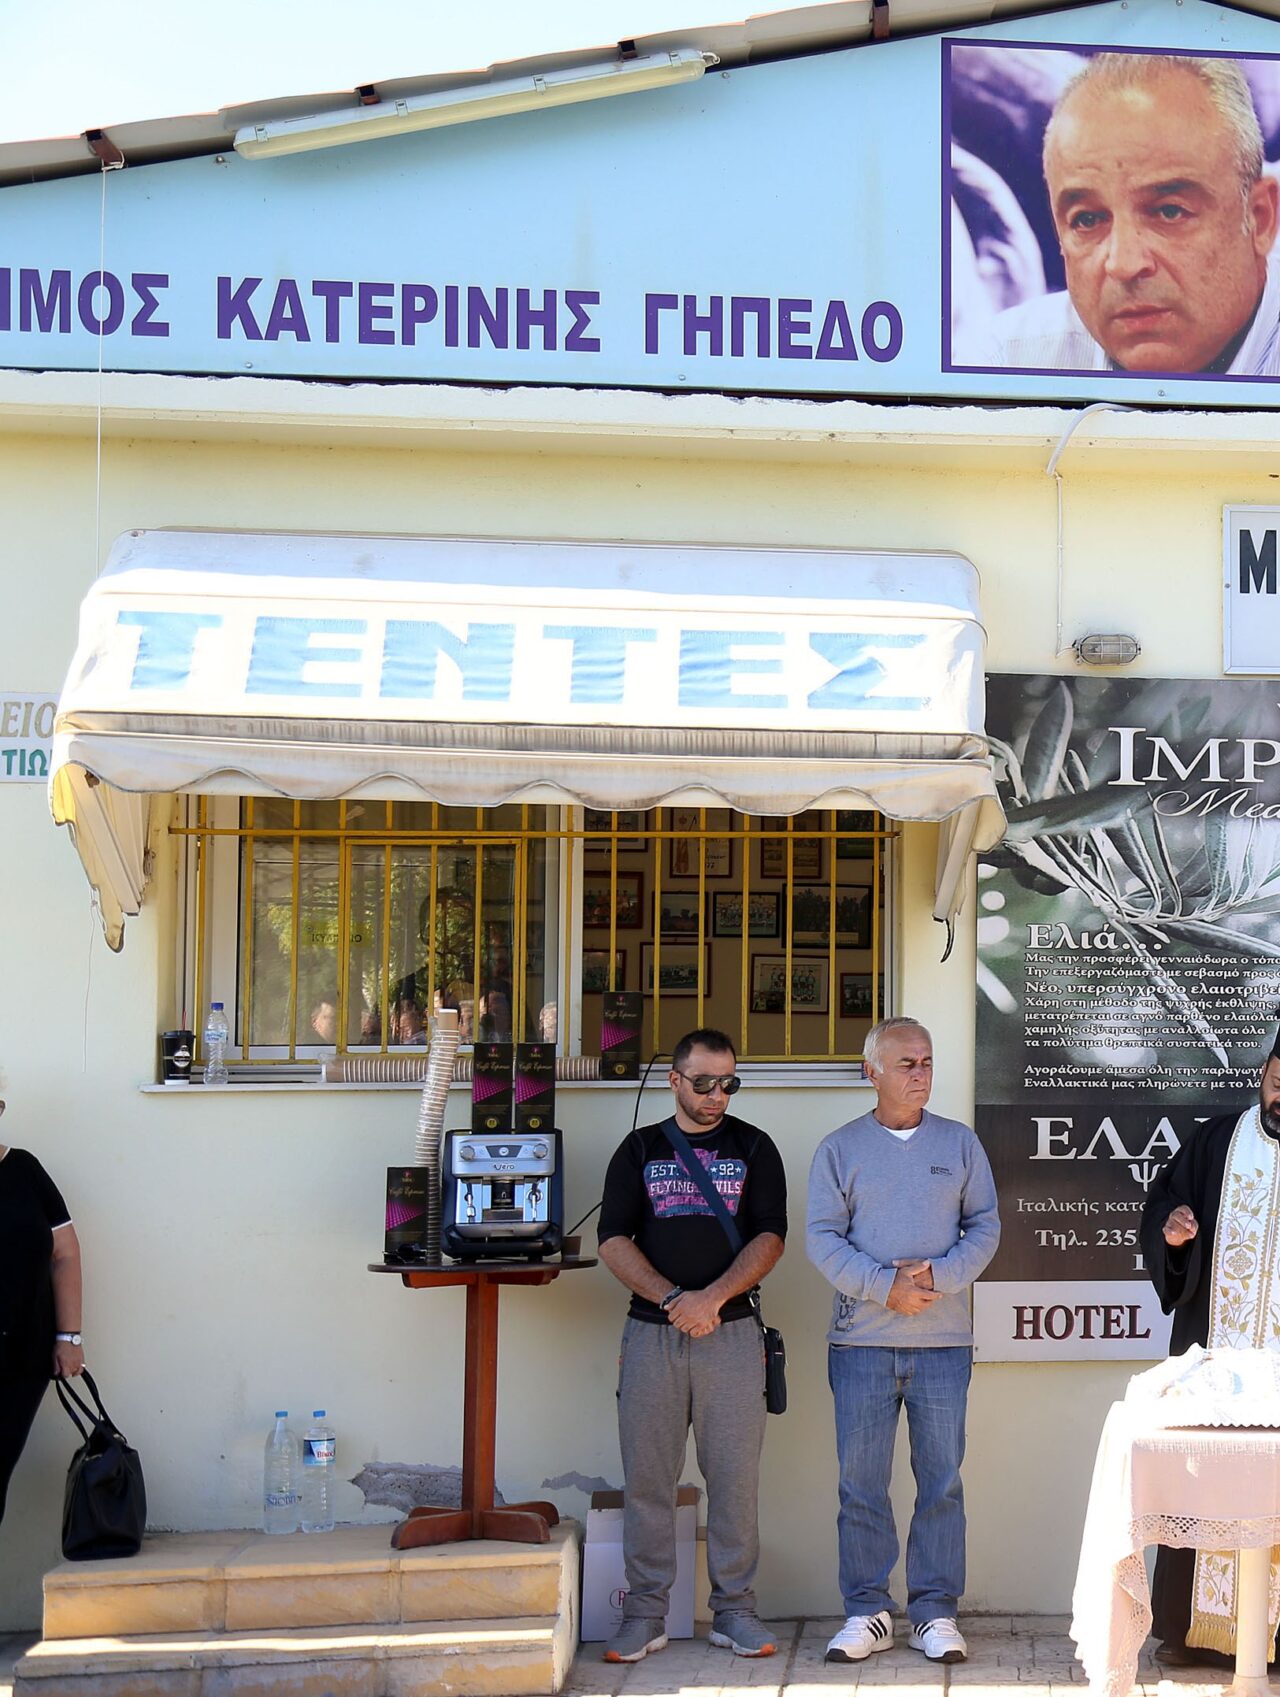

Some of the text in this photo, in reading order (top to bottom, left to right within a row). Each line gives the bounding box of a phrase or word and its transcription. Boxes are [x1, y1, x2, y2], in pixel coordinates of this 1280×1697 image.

[217, 276, 601, 352] ΚΑΤΕΡΙΝΗΣ
[644, 293, 904, 362] ΓΗΠΕΔΟ
[117, 610, 930, 711] ΤΕΝΤΕΣ
[1025, 953, 1053, 964] Μας
[1058, 955, 1079, 965] την
[1083, 953, 1149, 965] προσφέρει
[1154, 954, 1237, 966] γενναιόδωρα
[1025, 966, 1050, 977] Την
[1184, 968, 1239, 979] σεβασμό
[1243, 970, 1274, 980] προς
[1025, 981, 1062, 994] Νέο,
[1067, 982, 1186, 997] υπερσύγχρονο
[1025, 998, 1059, 1010] Χάρη
[1063, 1000, 1086, 1009] στη
[1090, 998, 1137, 1009] μέθοδο
[1140, 1000, 1162, 1010] της
[1165, 998, 1212, 1010] ψυχρής
[1025, 1010, 1110, 1021] μετατρέπεται
[1131, 1011, 1163, 1022] αγνό
[1166, 1011, 1220, 1022] παρθένο
[1025, 1023, 1266, 1036] χαμηλής οξύτητας με αναλλοίωτα όλα
[1024, 1039, 1040, 1047] τα
[1043, 1037, 1103, 1049] πολύτιμα
[1104, 1037, 1163, 1049] θρεπτικά
[1166, 1039, 1232, 1048] συστατικά
[1024, 1064, 1102, 1077] Αγοράζουμε
[1105, 1064, 1145, 1075] άμεσα
[1149, 1064, 1172, 1076] όλη
[1176, 1066, 1198, 1076] την
[1024, 1078, 1109, 1088] Εναλλακτικά
[1112, 1080, 1134, 1089] μας
[1137, 1078, 1207, 1090] πληρώνετε
[1210, 1081, 1226, 1090] με
[650, 1162, 734, 1178] EST. 92
[1017, 1198, 1099, 1215] Ιταλικής
[1035, 1229, 1087, 1250] Τηλ.
[1012, 1304, 1151, 1340] HOTEL
